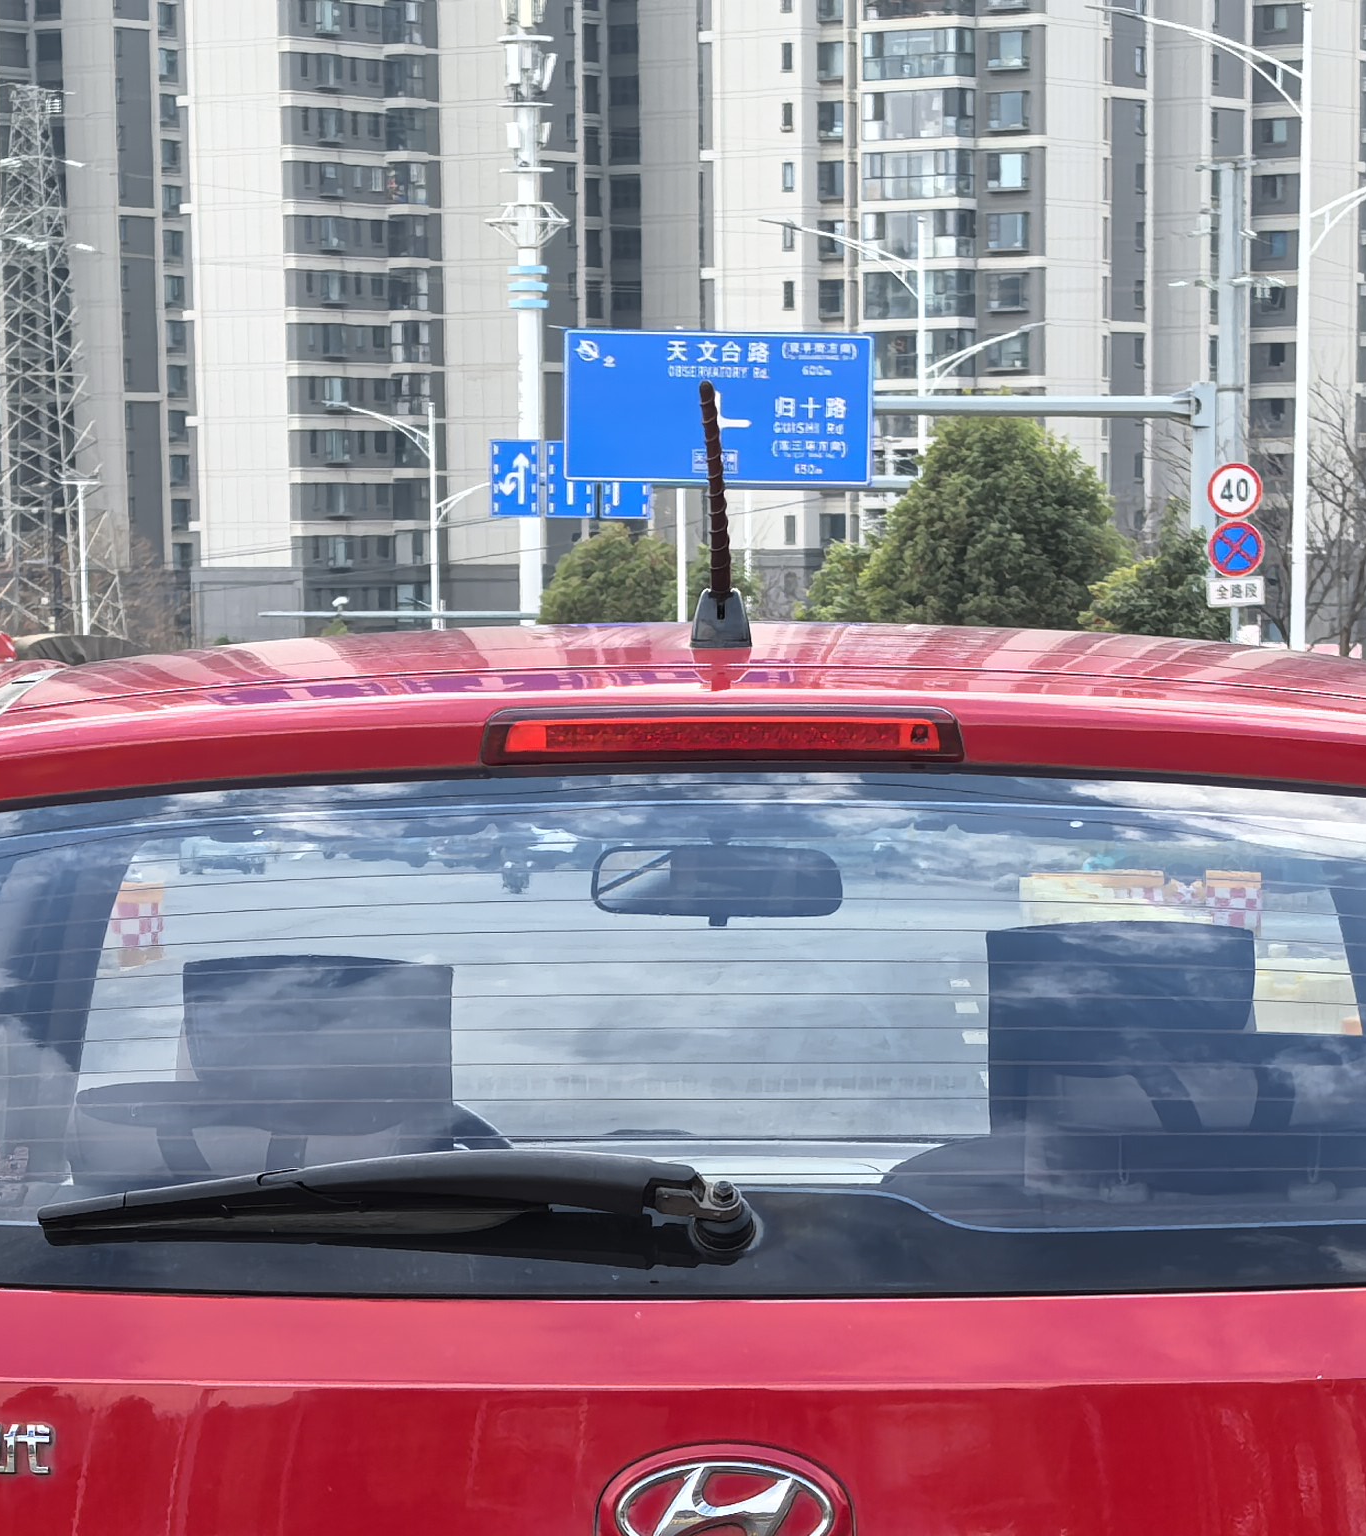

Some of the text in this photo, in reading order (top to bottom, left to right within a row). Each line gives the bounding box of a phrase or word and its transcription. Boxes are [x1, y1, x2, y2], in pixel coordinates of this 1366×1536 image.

[667, 341, 770, 362] 天文台路
[775, 397, 847, 418] 归十路
[773, 422, 819, 434] GUISHI
[1220, 478, 1250, 502] 40
[1216, 583, 1258, 600] 全路段
